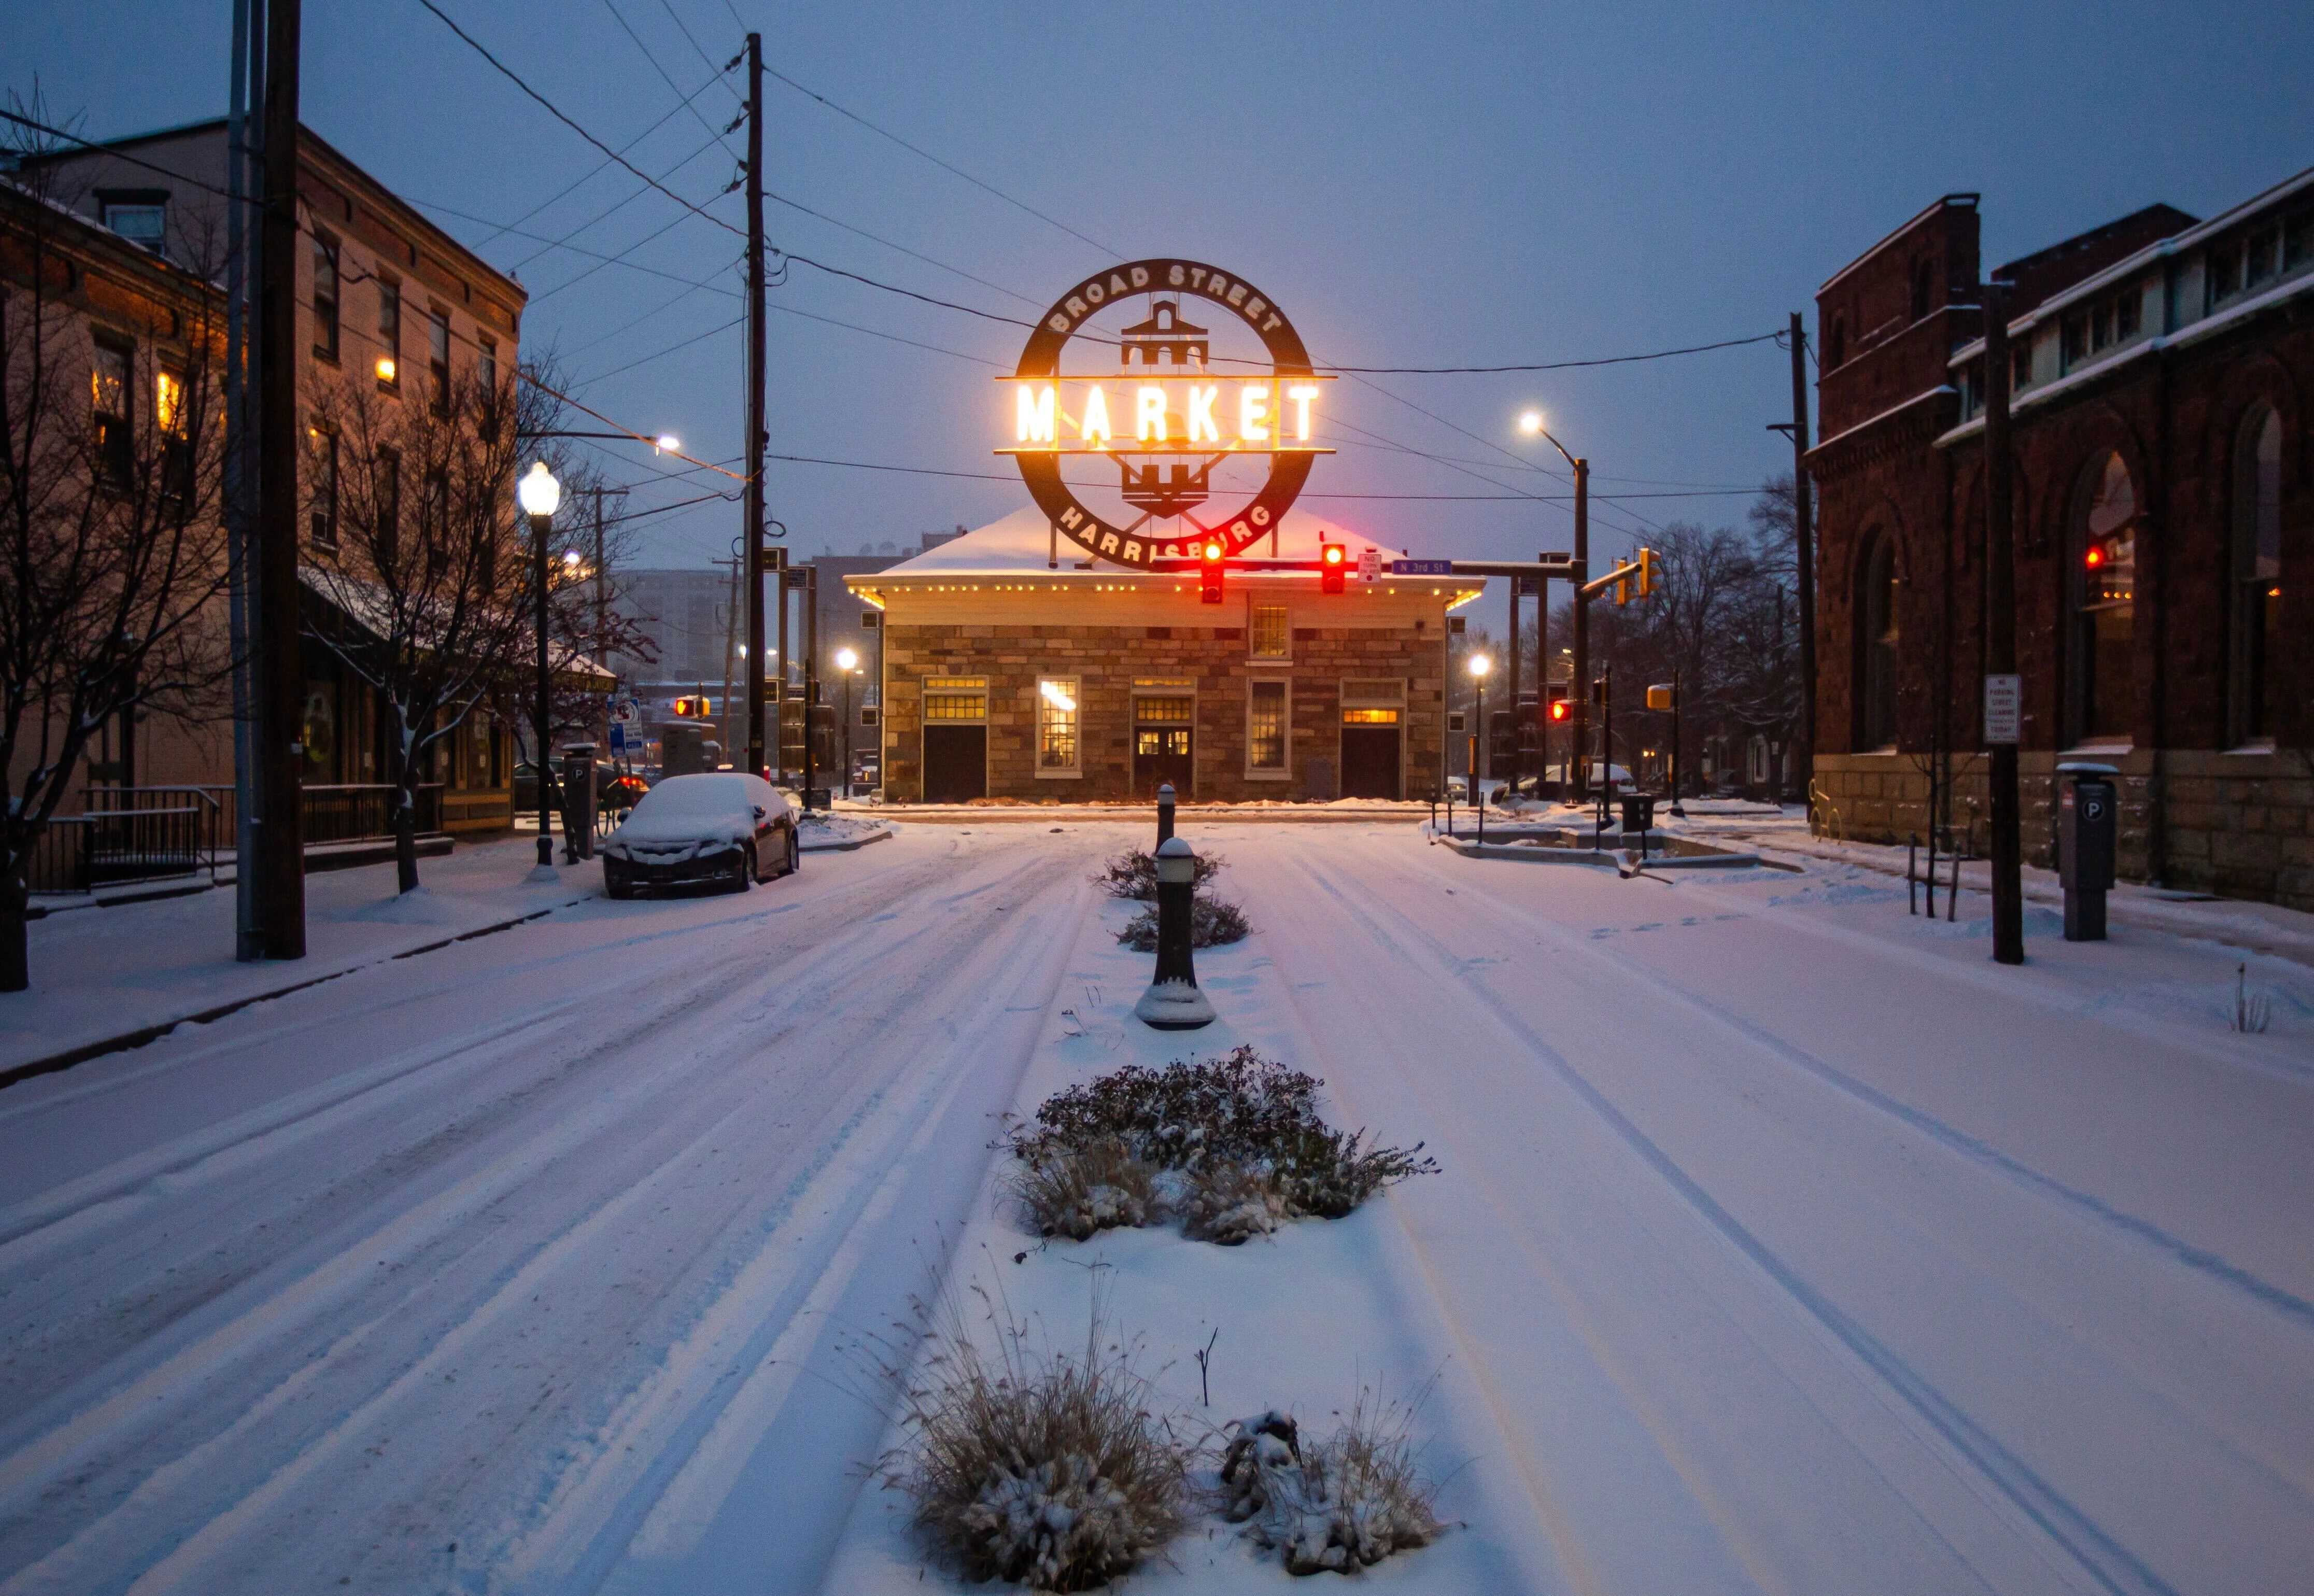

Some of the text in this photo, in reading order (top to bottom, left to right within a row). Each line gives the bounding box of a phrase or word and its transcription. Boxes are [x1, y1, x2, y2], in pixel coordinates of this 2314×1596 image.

[1048, 265, 1282, 333] BROAD STREET
[1016, 385, 1319, 441] MARKET
[1401, 563, 1444, 572] N 3rd St
[575, 769, 583, 779] P
[2088, 802, 2100, 817] P
